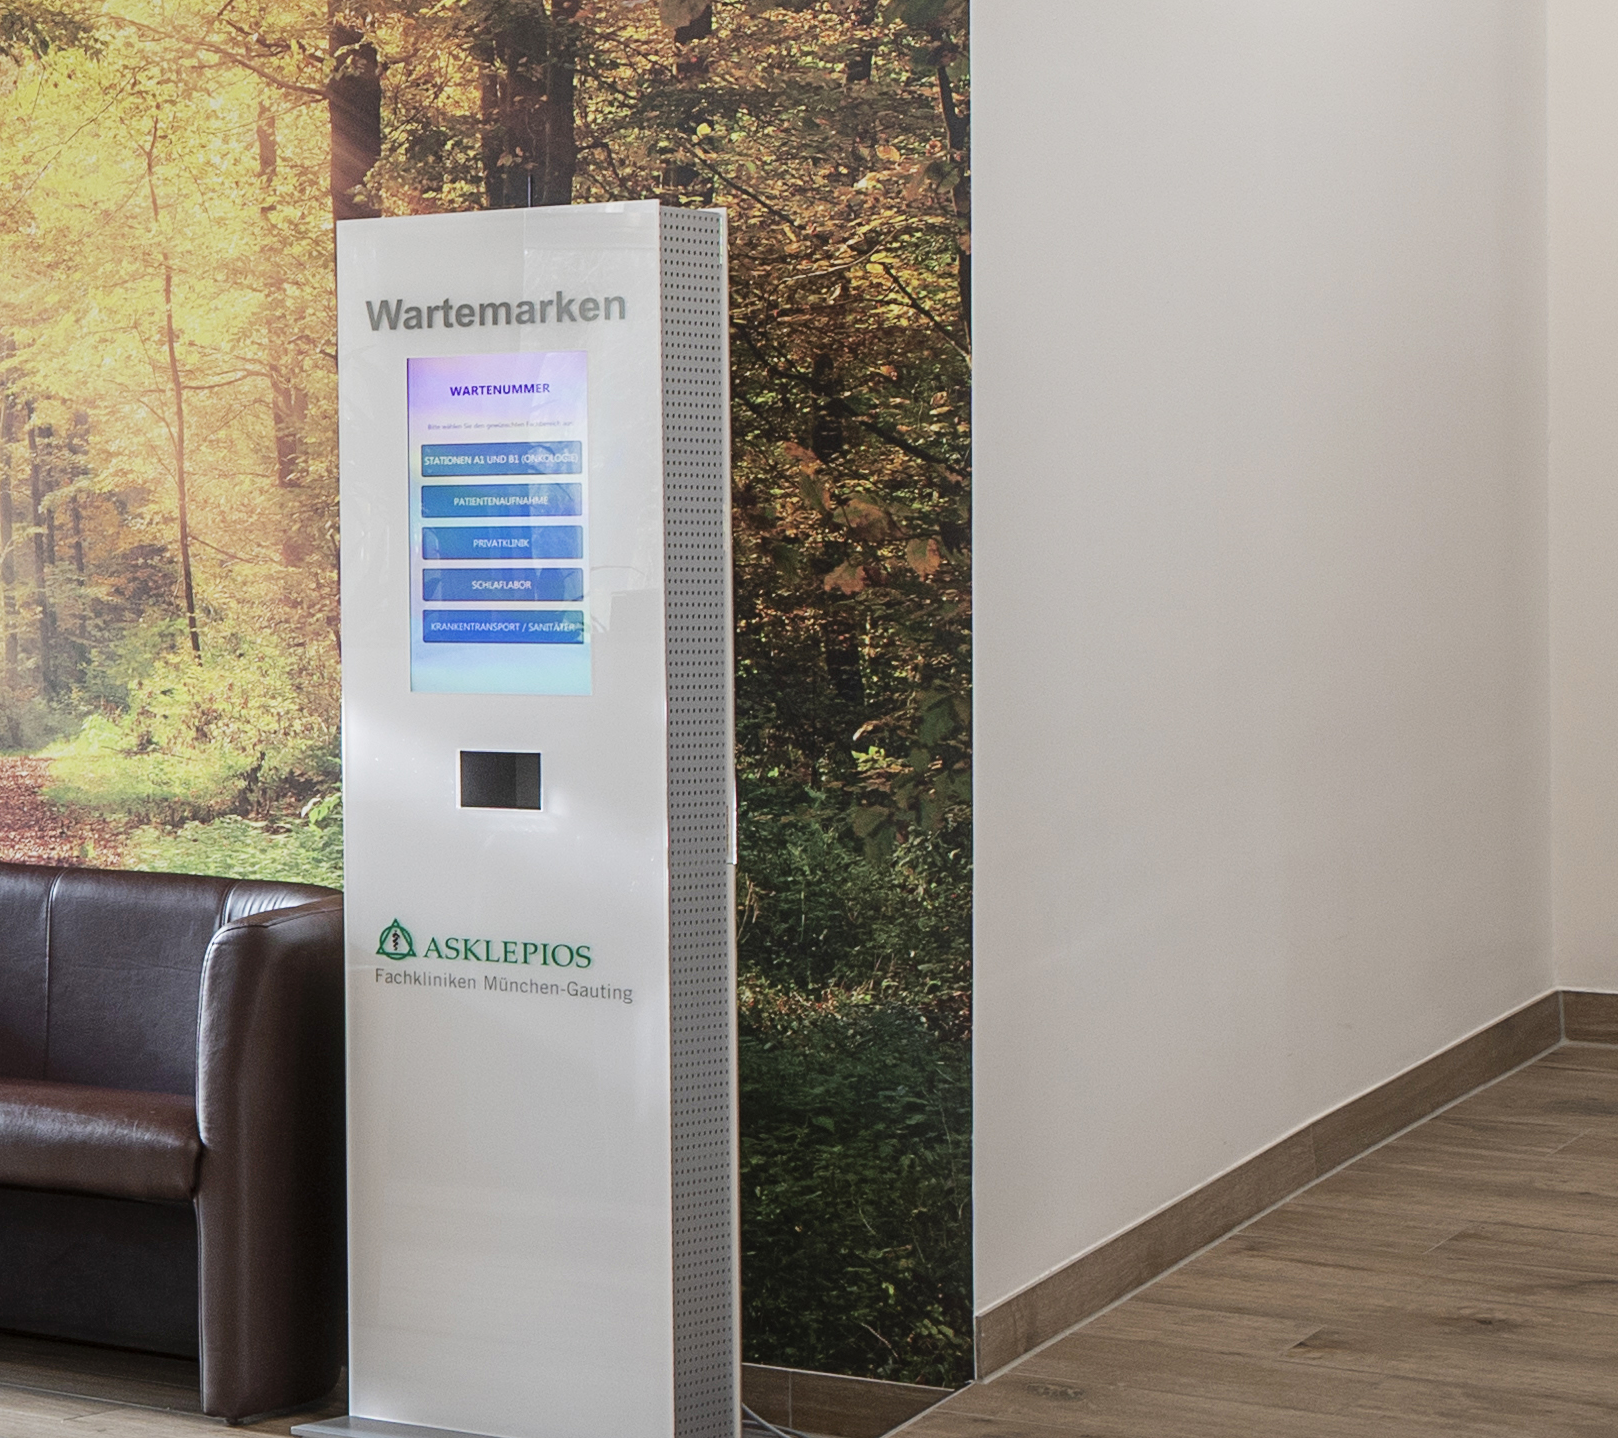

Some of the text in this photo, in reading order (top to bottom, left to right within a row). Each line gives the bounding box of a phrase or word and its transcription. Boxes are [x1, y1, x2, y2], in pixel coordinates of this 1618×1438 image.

[365, 290, 627, 331] Wartemarken
[450, 383, 551, 397] WARTENUMMER
[424, 452, 579, 466] STATIONEN A1 UND B1 (ONKOLOGIE)
[453, 496, 549, 506] PATIENTENAUFNAHME
[472, 538, 530, 548] PRIVATKLINIK
[471, 580, 532, 590] SCHLAFLABOR
[430, 622, 520, 631] KRANKENTRANSPORT
[528, 620, 576, 632] SANITÄTER
[423, 937, 592, 969] ASKLEPIOS
[374, 968, 634, 1005] Fachkliniken München-Gauting
